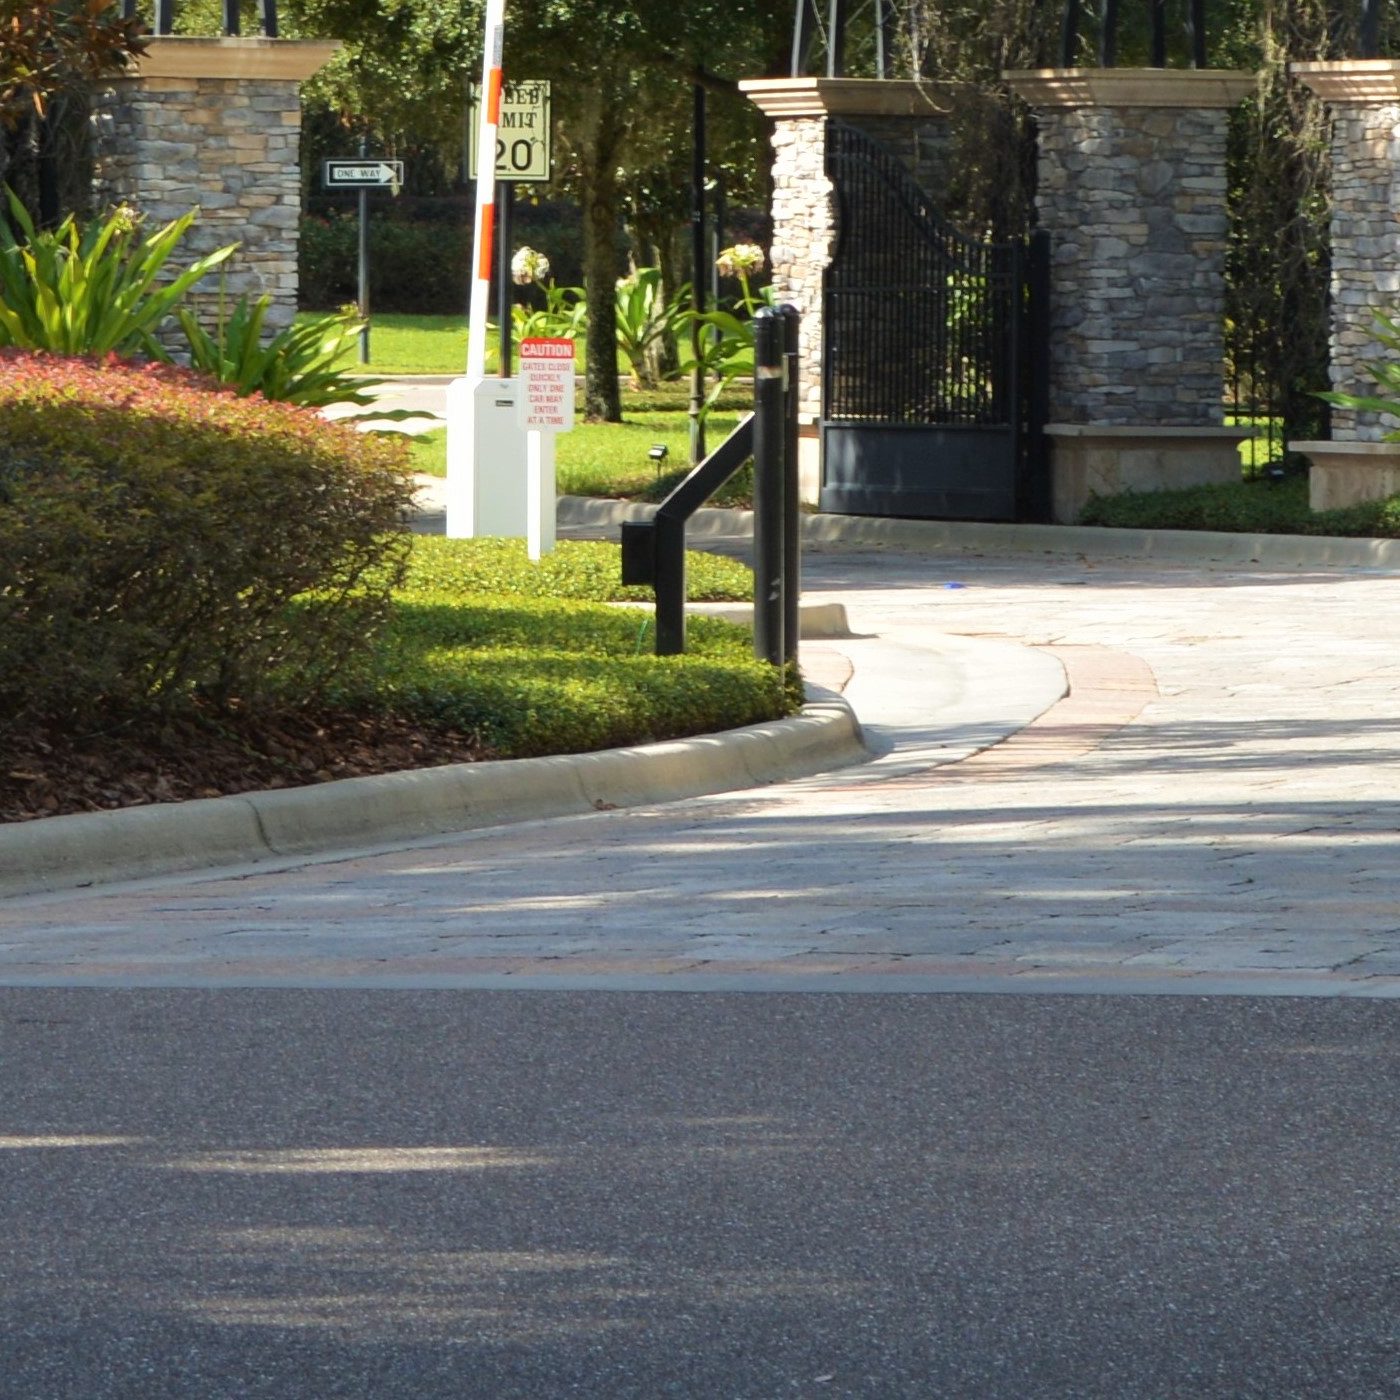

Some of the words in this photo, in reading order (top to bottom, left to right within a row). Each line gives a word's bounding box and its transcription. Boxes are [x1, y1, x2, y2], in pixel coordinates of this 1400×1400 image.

[498, 112, 538, 128] MIT
[338, 169, 355, 177] ONE
[360, 169, 380, 177] WAY
[522, 343, 572, 356] CAUTION
[522, 363, 546, 371] GATES
[548, 363, 570, 371] CLOSE
[530, 373, 561, 381] QUICKLY
[528, 384, 547, 392] ONLY
[551, 384, 565, 392] ONE
[529, 395, 544, 403] CAR
[546, 395, 562, 403] MAY
[534, 406, 557, 414] ENTER
[546, 416, 564, 424] TIME
